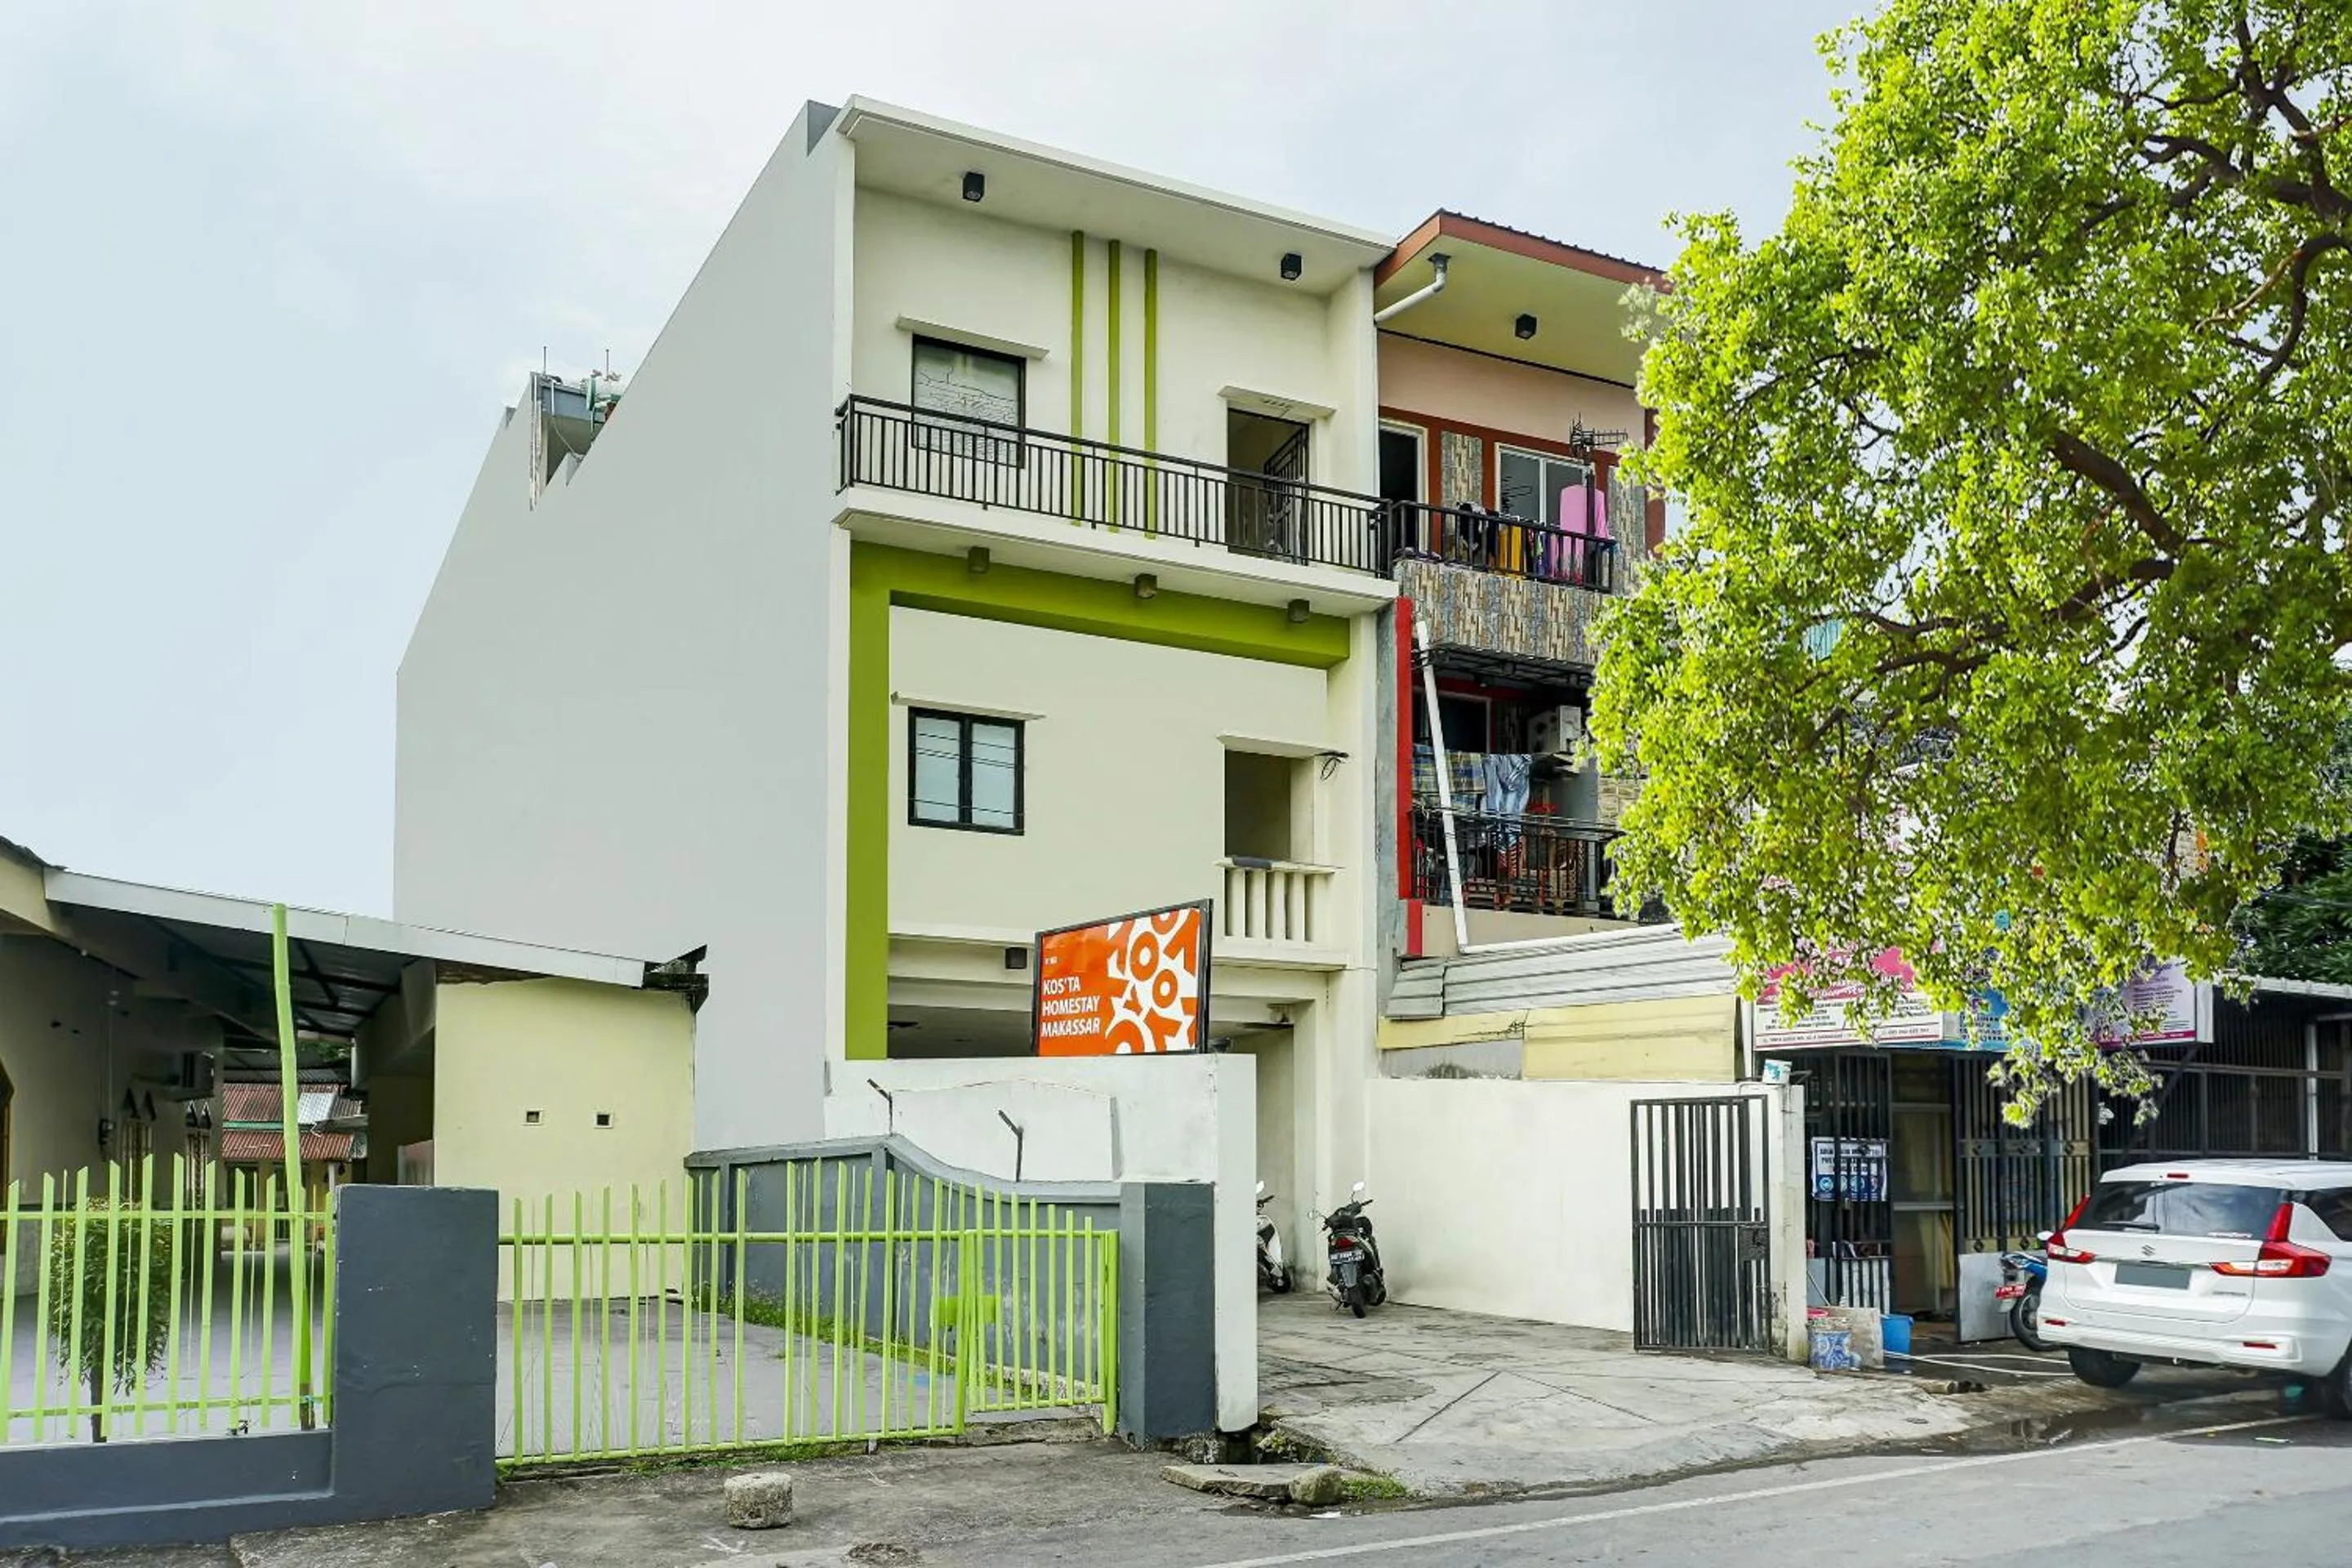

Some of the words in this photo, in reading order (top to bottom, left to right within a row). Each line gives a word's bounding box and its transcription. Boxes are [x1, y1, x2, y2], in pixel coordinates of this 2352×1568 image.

[1043, 976, 1080, 995] KOS'TA
[1042, 995, 1100, 1016] HOMESTAY
[1040, 1017, 1100, 1037] MAKASSAR
